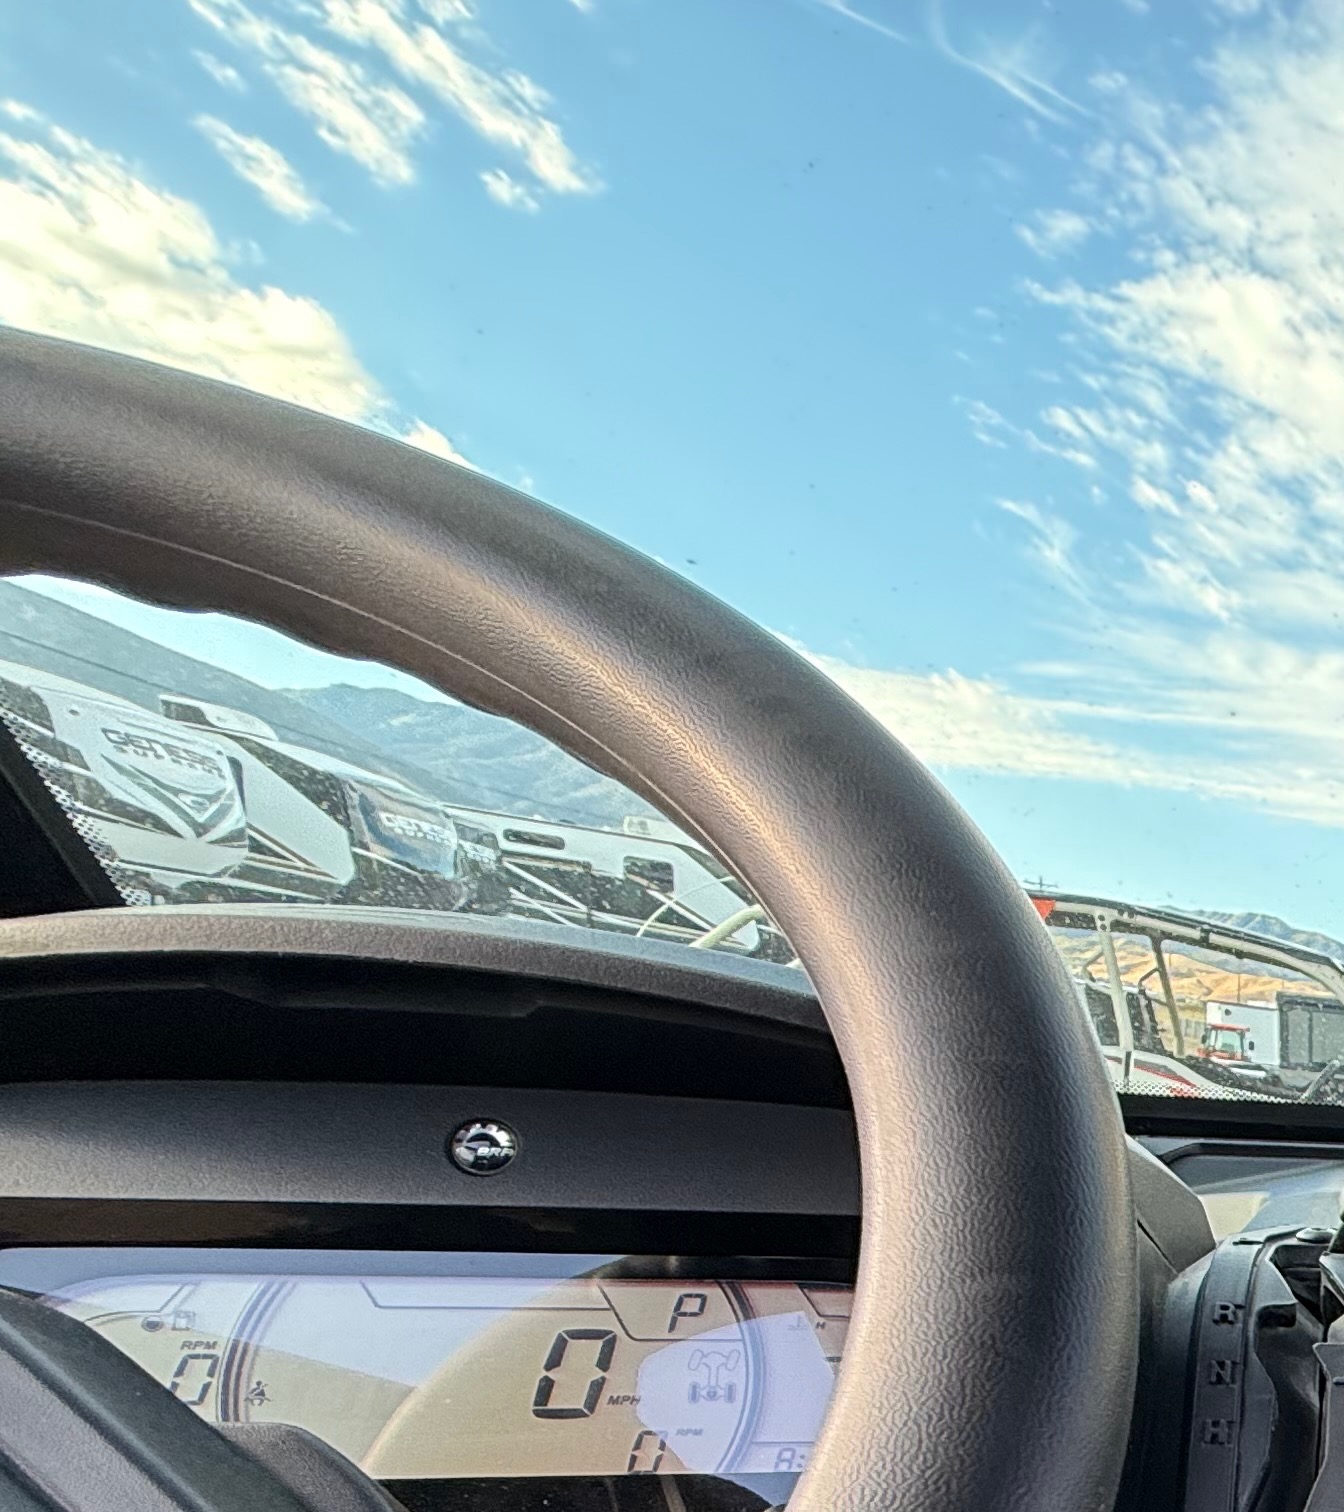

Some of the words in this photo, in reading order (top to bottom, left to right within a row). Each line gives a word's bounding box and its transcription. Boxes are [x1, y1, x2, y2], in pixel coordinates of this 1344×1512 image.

[668, 1292, 708, 1334] P
[180, 1340, 218, 1351] RPM
[532, 1328, 618, 1420] 0
[606, 1394, 642, 1407] MPH
[676, 1427, 704, 1437] RPM
